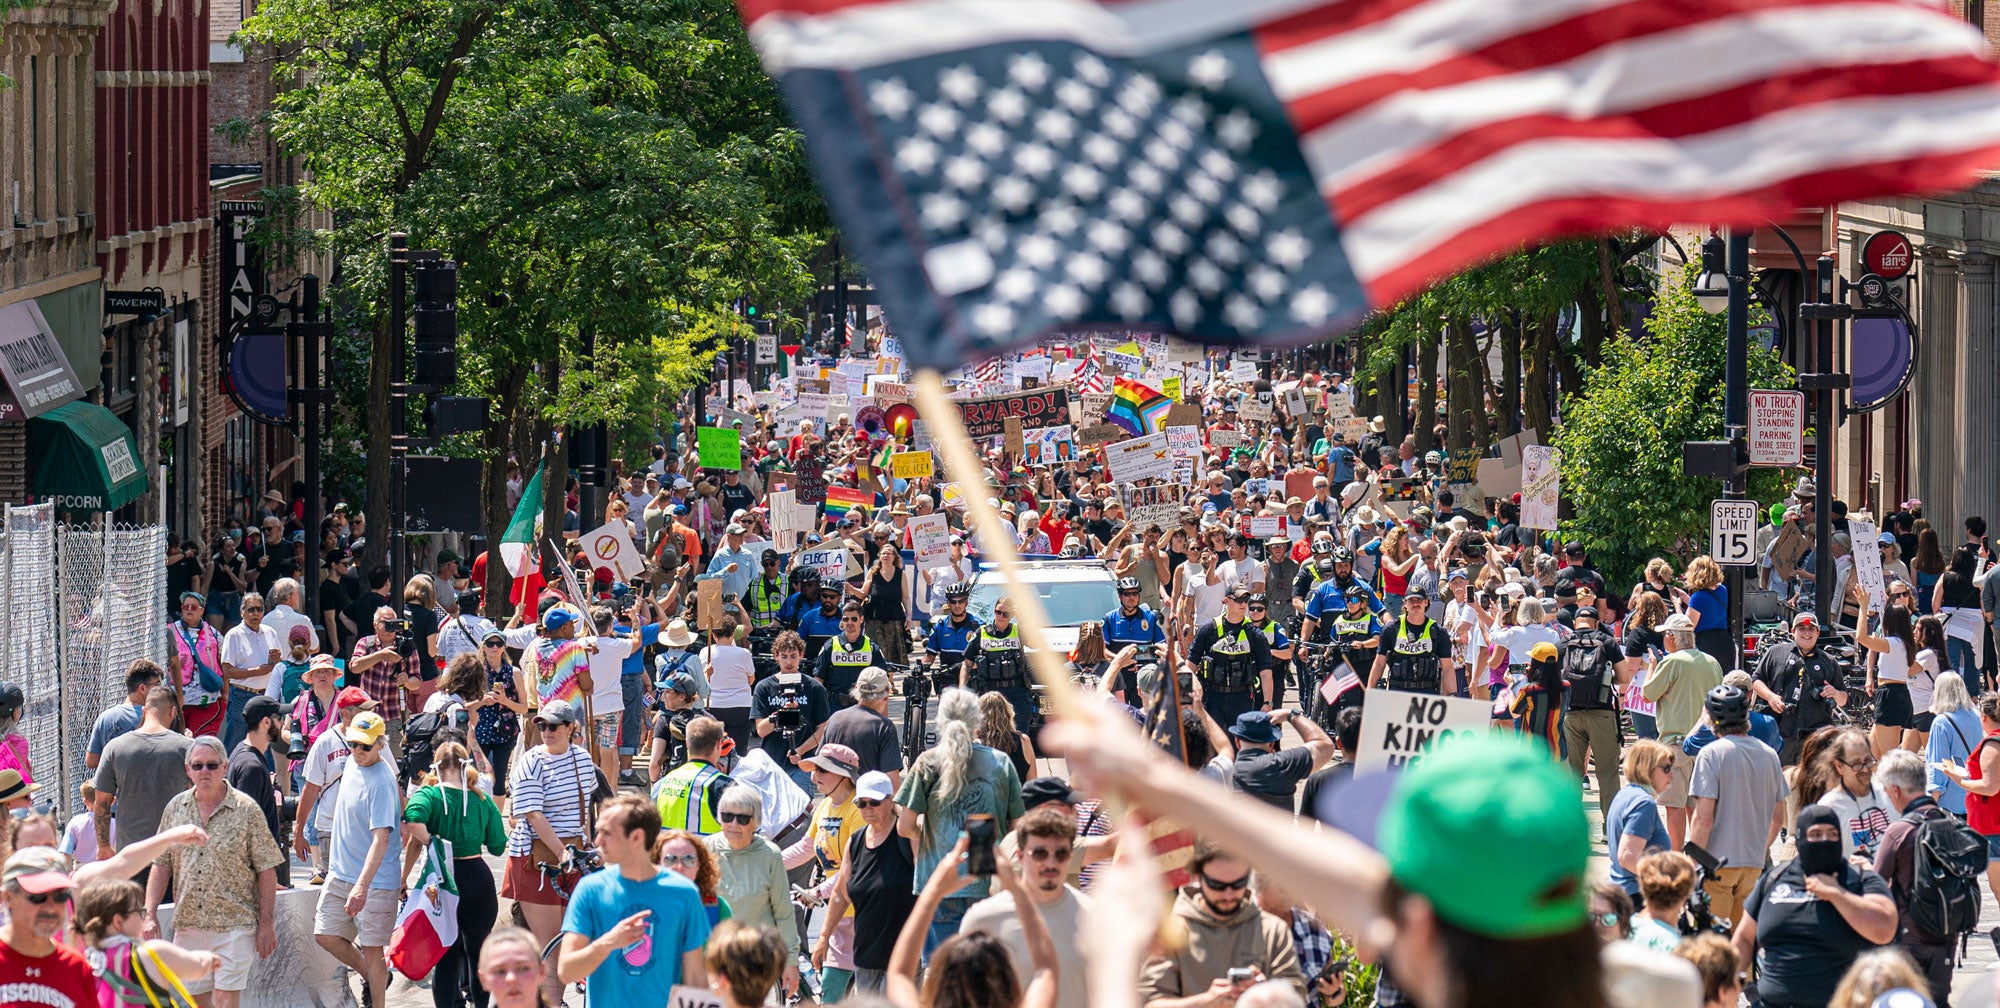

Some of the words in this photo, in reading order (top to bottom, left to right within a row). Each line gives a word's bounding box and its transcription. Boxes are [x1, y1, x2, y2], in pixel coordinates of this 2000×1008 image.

[221, 202, 264, 211] DUELING
[1882, 254, 1906, 267] ian's
[109, 298, 158, 307] TAVERN
[758, 337, 774, 345] ONE
[1107, 351, 1141, 365] DEMOCRACY
[1113, 360, 1131, 370] NOT
[875, 383, 884, 394] NO
[884, 384, 907, 396] KINGS
[1755, 396, 1767, 408] NO
[1770, 396, 1797, 409] TRUCK
[953, 392, 1056, 425] ORWARD!
[1757, 408, 1795, 418] STOPPING
[1021, 417, 1042, 428] AND
[1757, 418, 1795, 428] STANDING
[1167, 426, 1186, 434] WHEN
[1759, 430, 1792, 440] PARKING
[1169, 433, 1196, 441] TYRANNY
[1170, 441, 1198, 449] BECOMES
[1754, 440, 1773, 449] ENTIRE
[1776, 441, 1796, 449] STREET
[801, 461, 815, 469] ICE
[800, 470, 814, 479] THE
[801, 478, 823, 487] NEW
[41, 494, 102, 509] POPCORN
[1716, 507, 1753, 519] SPEED
[1719, 519, 1749, 531] LIMIT
[1719, 533, 1748, 559] 15
[802, 551, 831, 565] ELECT
[834, 553, 843, 564] A
[816, 564, 843, 577] PIST
[1399, 643, 1428, 653] POLICE
[835, 655, 868, 663] POLICE
[1406, 696, 1448, 726] NO
[662, 788, 685, 799] POLICE
